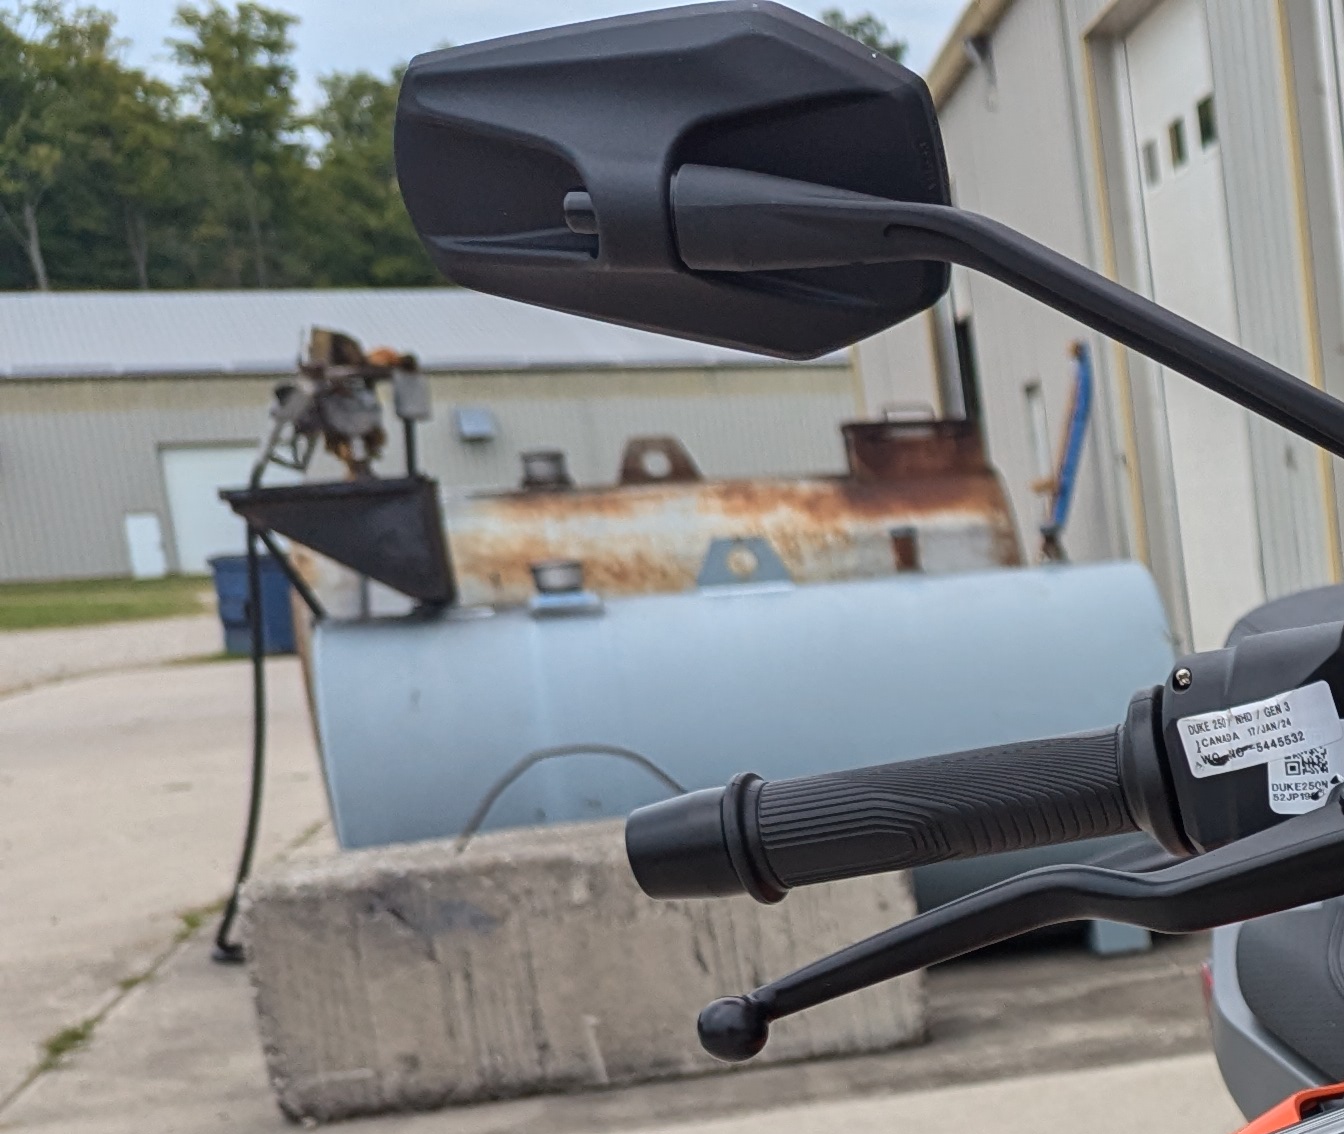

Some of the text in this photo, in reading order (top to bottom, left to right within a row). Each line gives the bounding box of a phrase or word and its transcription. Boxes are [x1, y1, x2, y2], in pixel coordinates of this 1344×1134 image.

[1188, 721, 1211, 735] DUKE
[1212, 717, 1227, 730] 250
[1264, 704, 1282, 717] GEN
[1284, 701, 1291, 712] 3
[1247, 717, 1292, 736] 17/JAN/24
[1256, 731, 1305, 752] 5445532
